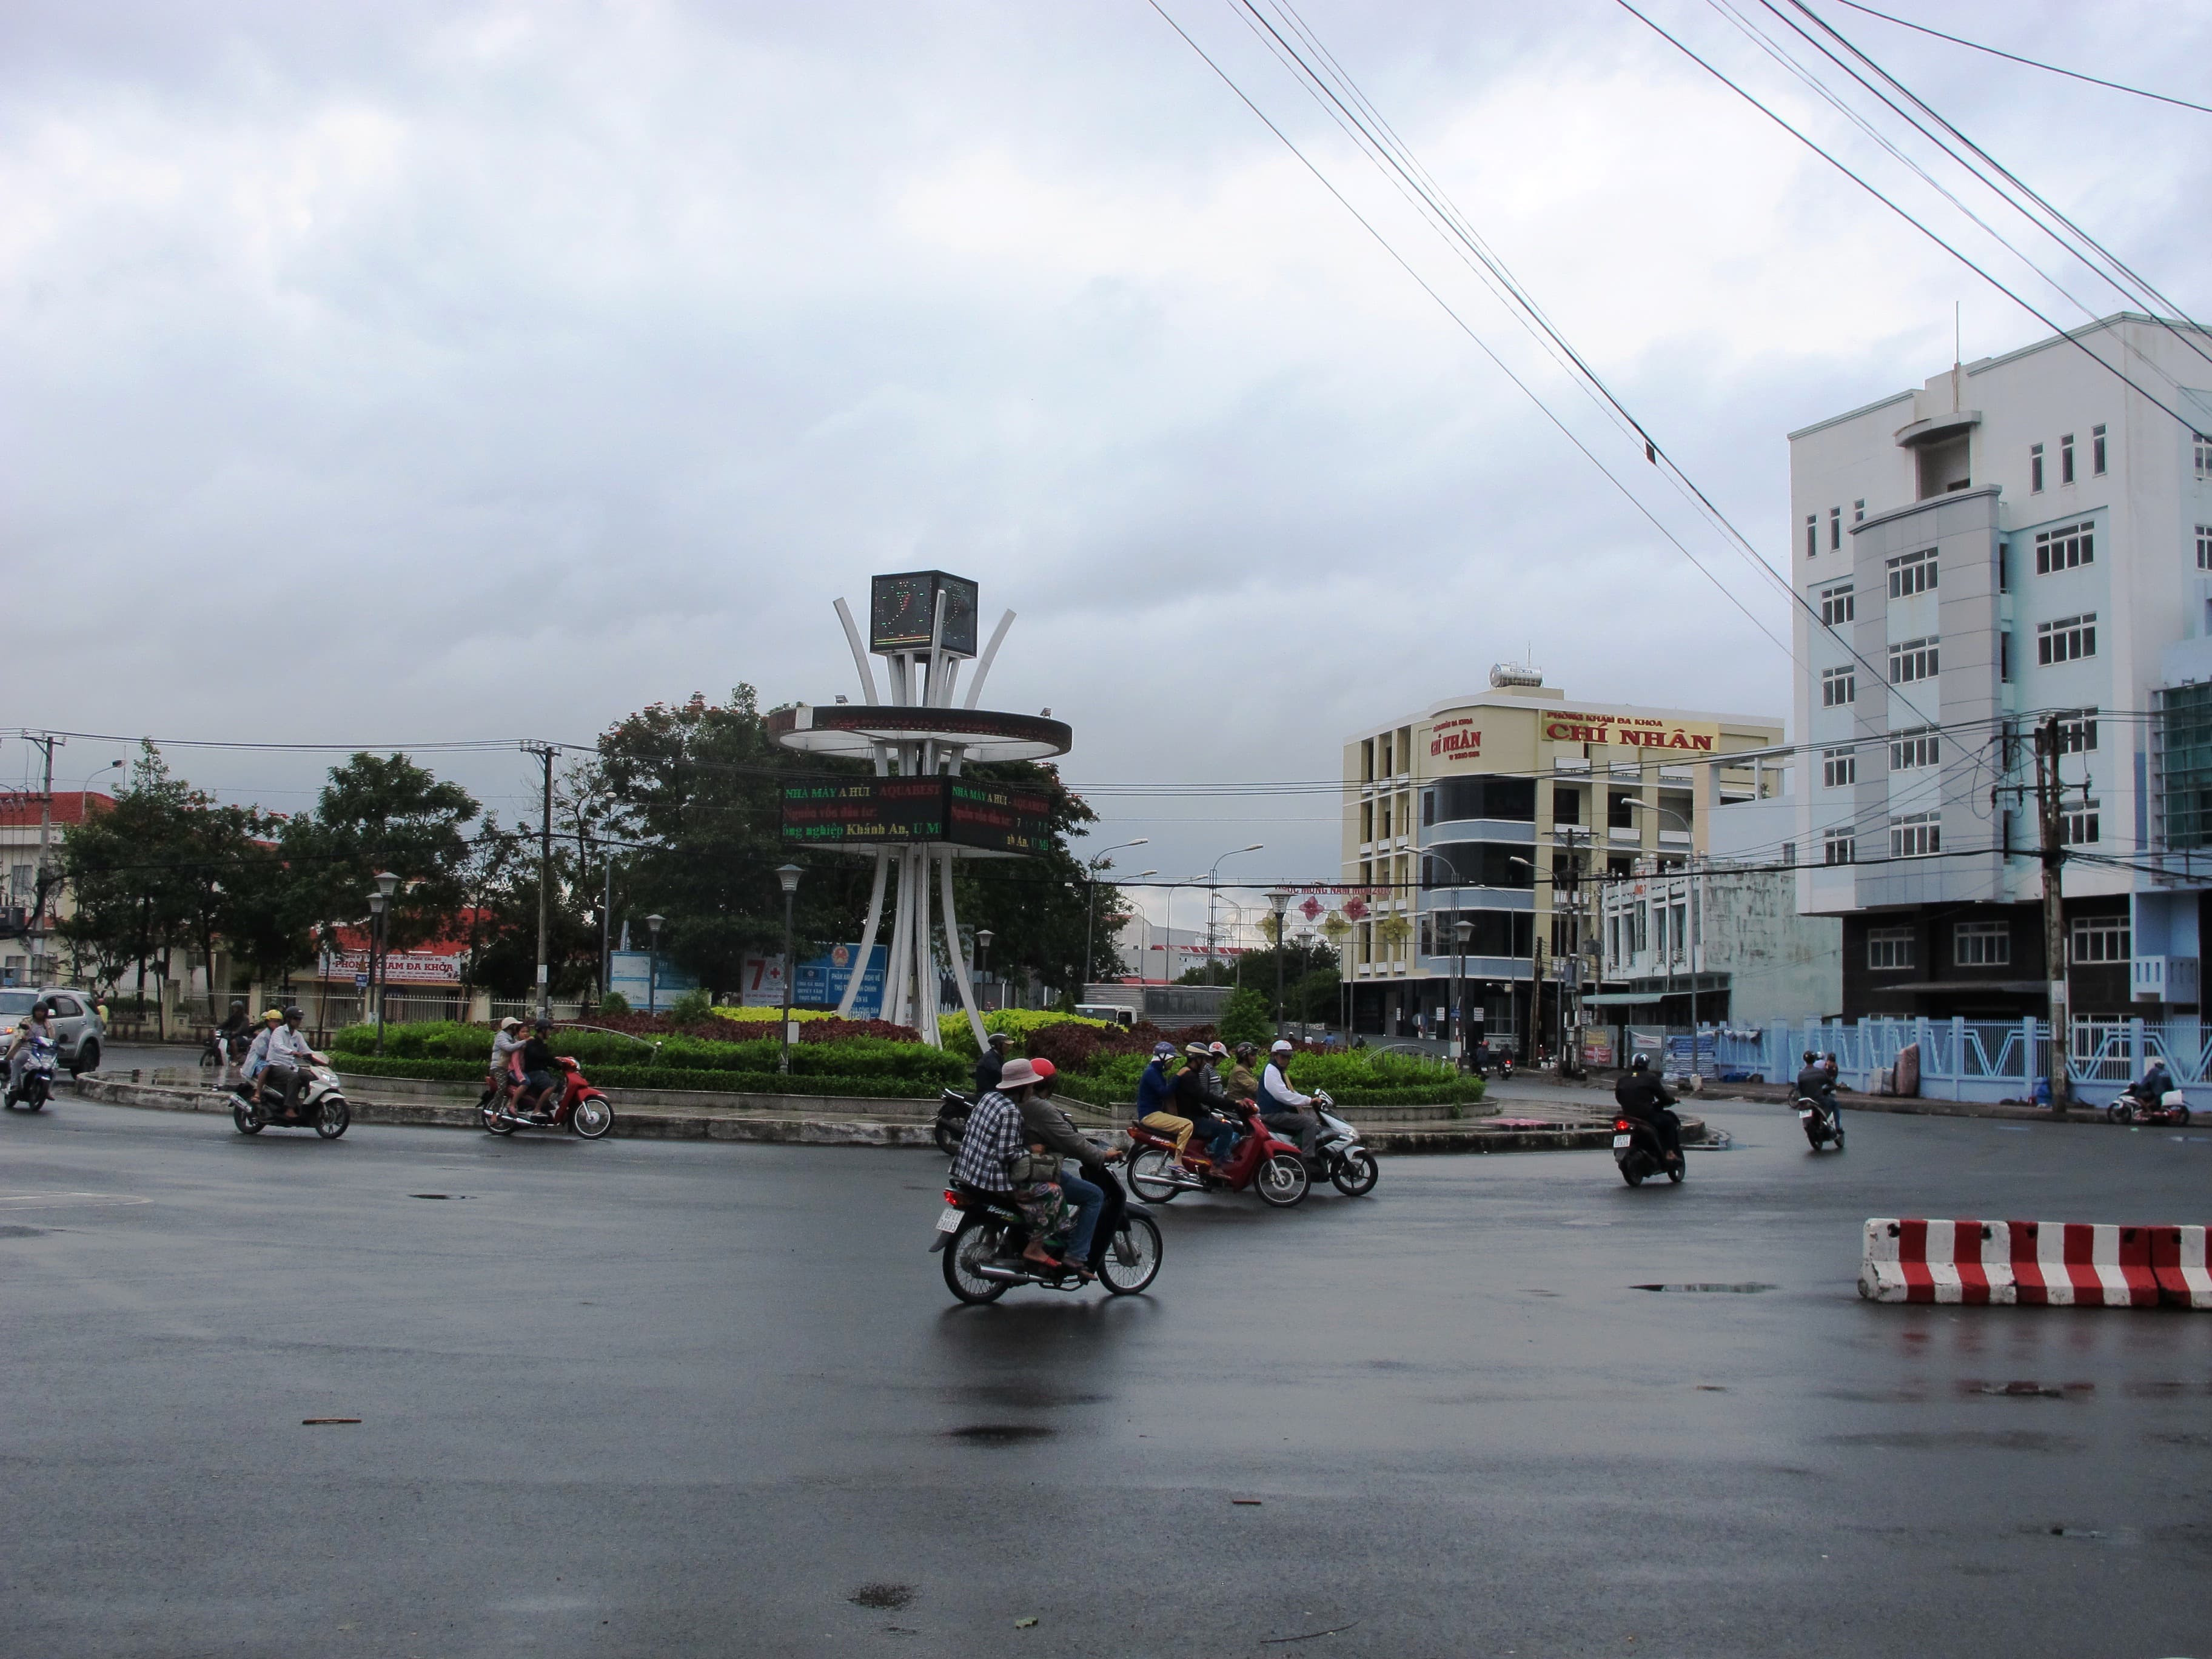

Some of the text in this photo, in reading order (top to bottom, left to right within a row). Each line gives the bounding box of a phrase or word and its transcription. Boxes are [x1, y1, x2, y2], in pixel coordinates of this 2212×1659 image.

[1547, 711, 1583, 720] PHÒNG
[1443, 729, 1481, 752] NHÂN
[1547, 722, 1714, 750] CHÍ NHÂN
[846, 822, 885, 835] Khánh
[914, 823, 922, 834] U
[987, 1204, 1014, 1216] Wave
